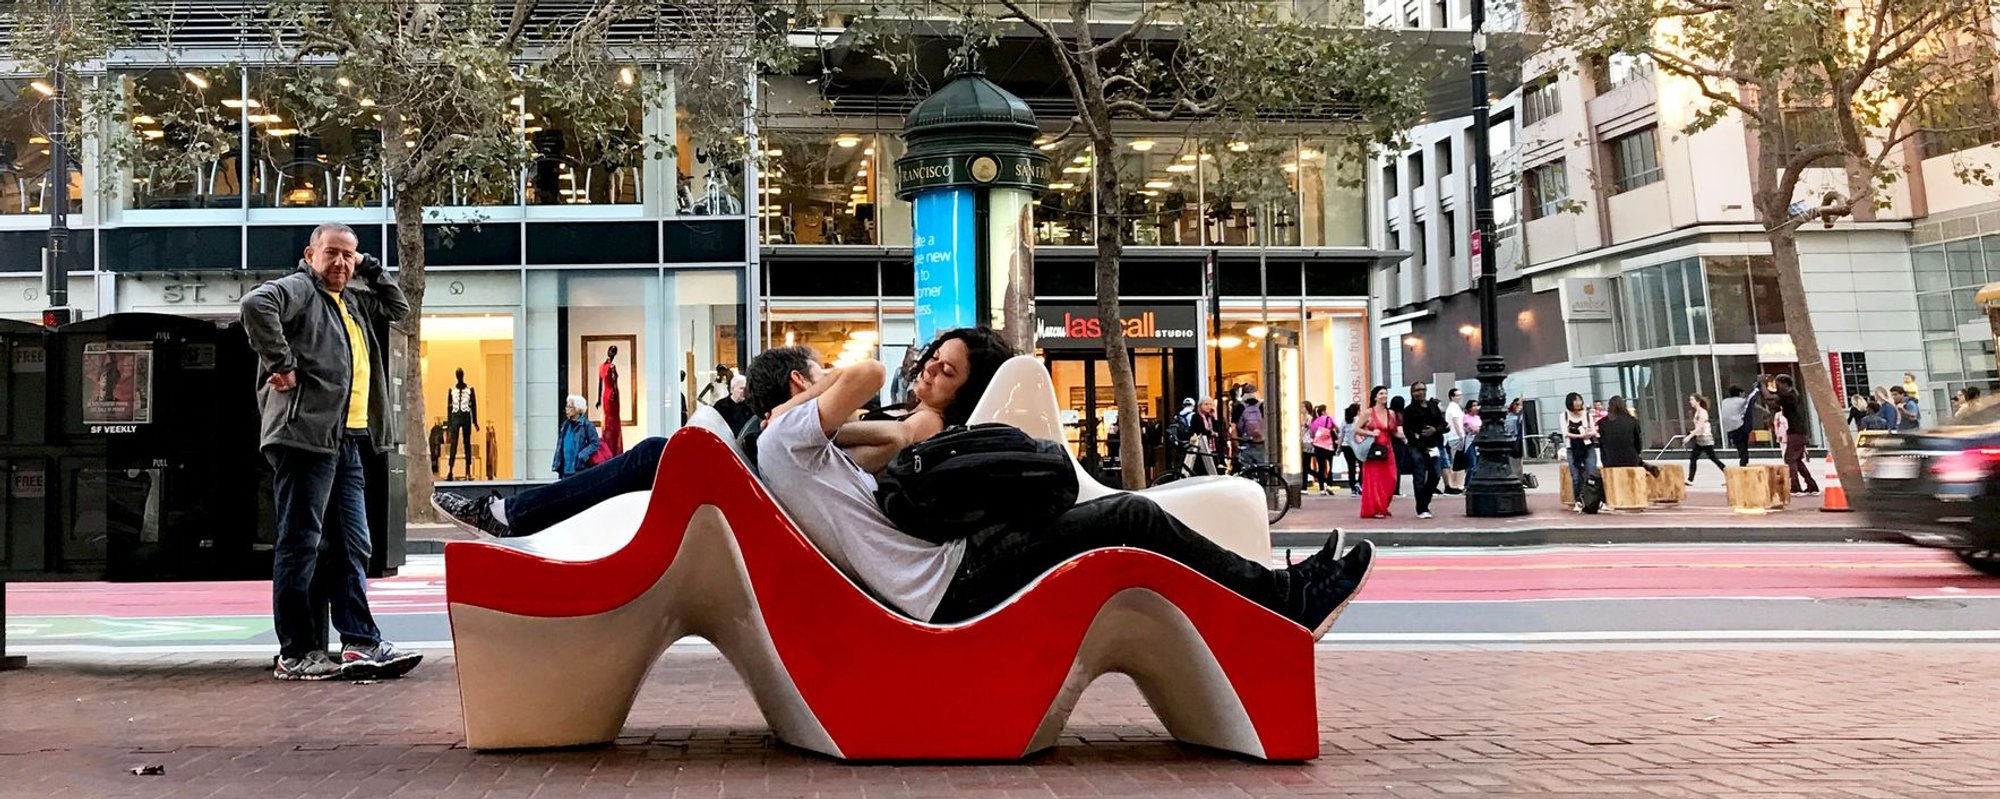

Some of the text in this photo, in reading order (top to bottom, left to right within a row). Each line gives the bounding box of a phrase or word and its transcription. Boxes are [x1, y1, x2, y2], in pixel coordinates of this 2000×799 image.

[902, 164, 951, 182] RANCISCO
[1015, 163, 1034, 177] SAN
[928, 235, 935, 247] a
[926, 250, 951, 263] new
[920, 269, 930, 281] to
[163, 283, 207, 303] ST.
[917, 286, 942, 299] omer
[1065, 312, 1102, 338] las
[1155, 329, 1194, 338] STUDIO
[15, 350, 45, 363] FREE
[90, 425, 102, 434] SF
[153, 459, 167, 467] PULL
[15, 475, 43, 487] FREE
